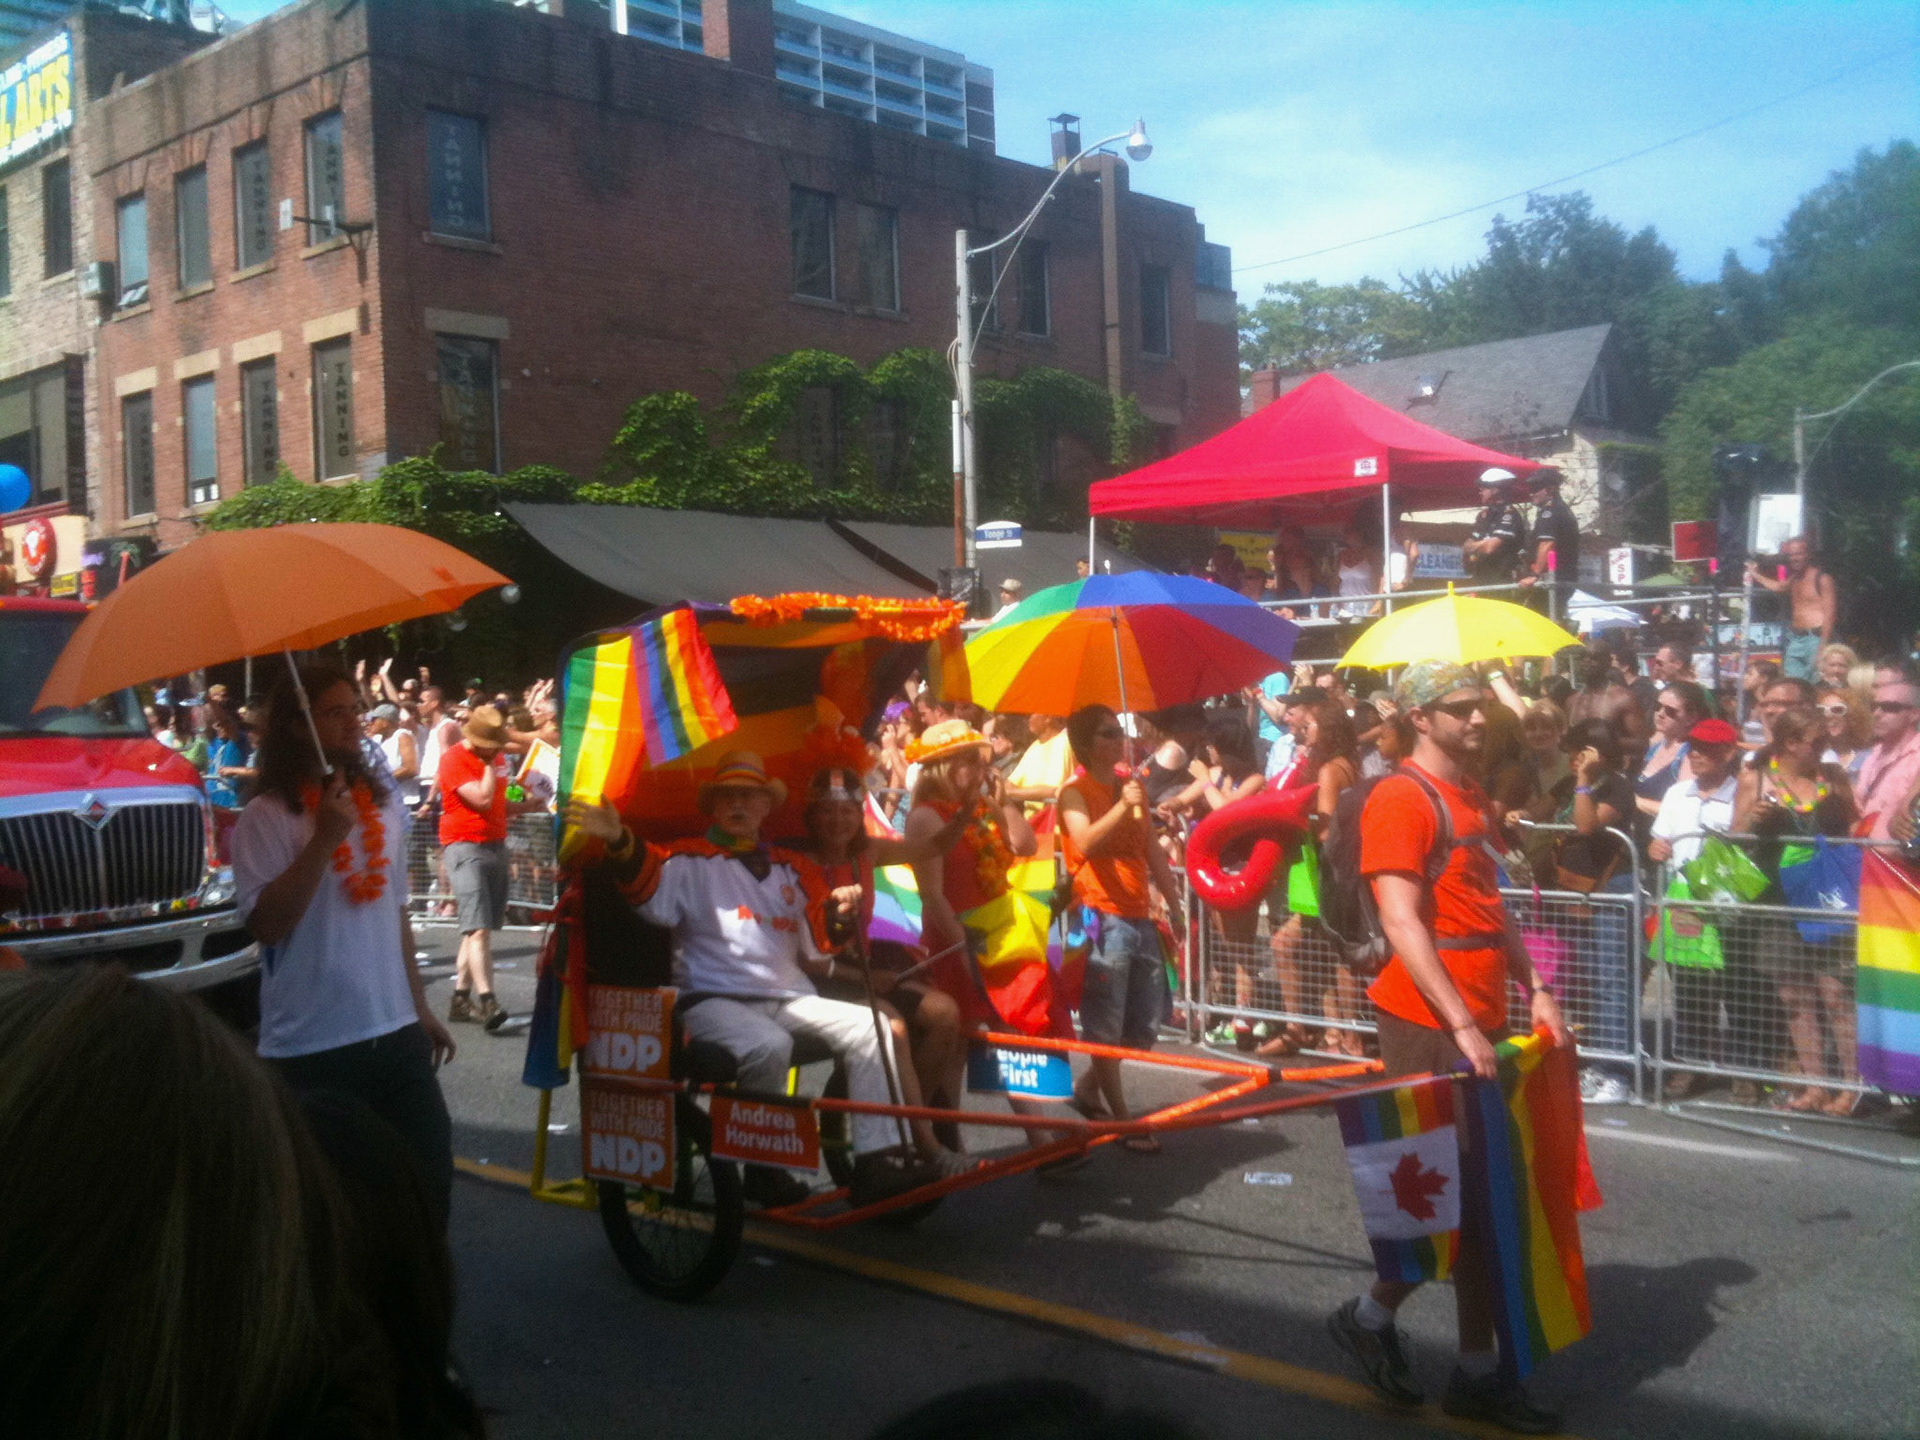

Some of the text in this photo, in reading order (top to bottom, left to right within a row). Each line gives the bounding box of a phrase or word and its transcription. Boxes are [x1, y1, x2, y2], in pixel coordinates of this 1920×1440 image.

[14, 54, 70, 141] ARTS
[253, 160, 267, 251] TANNING
[335, 361, 350, 458] TANNING
[262, 380, 276, 472] TANNING
[984, 529, 1005, 540] Yonge
[588, 987, 663, 1012] TOGETHER
[623, 1012, 662, 1033] PRIDE
[584, 1030, 663, 1072] NDP
[999, 1063, 1039, 1089] First
[591, 1091, 666, 1118] TOGETHER
[730, 1101, 797, 1131] Andrea
[591, 1111, 665, 1141] WITH PRIDE
[725, 1123, 804, 1155] Horwath
[590, 1133, 666, 1179] NDP
